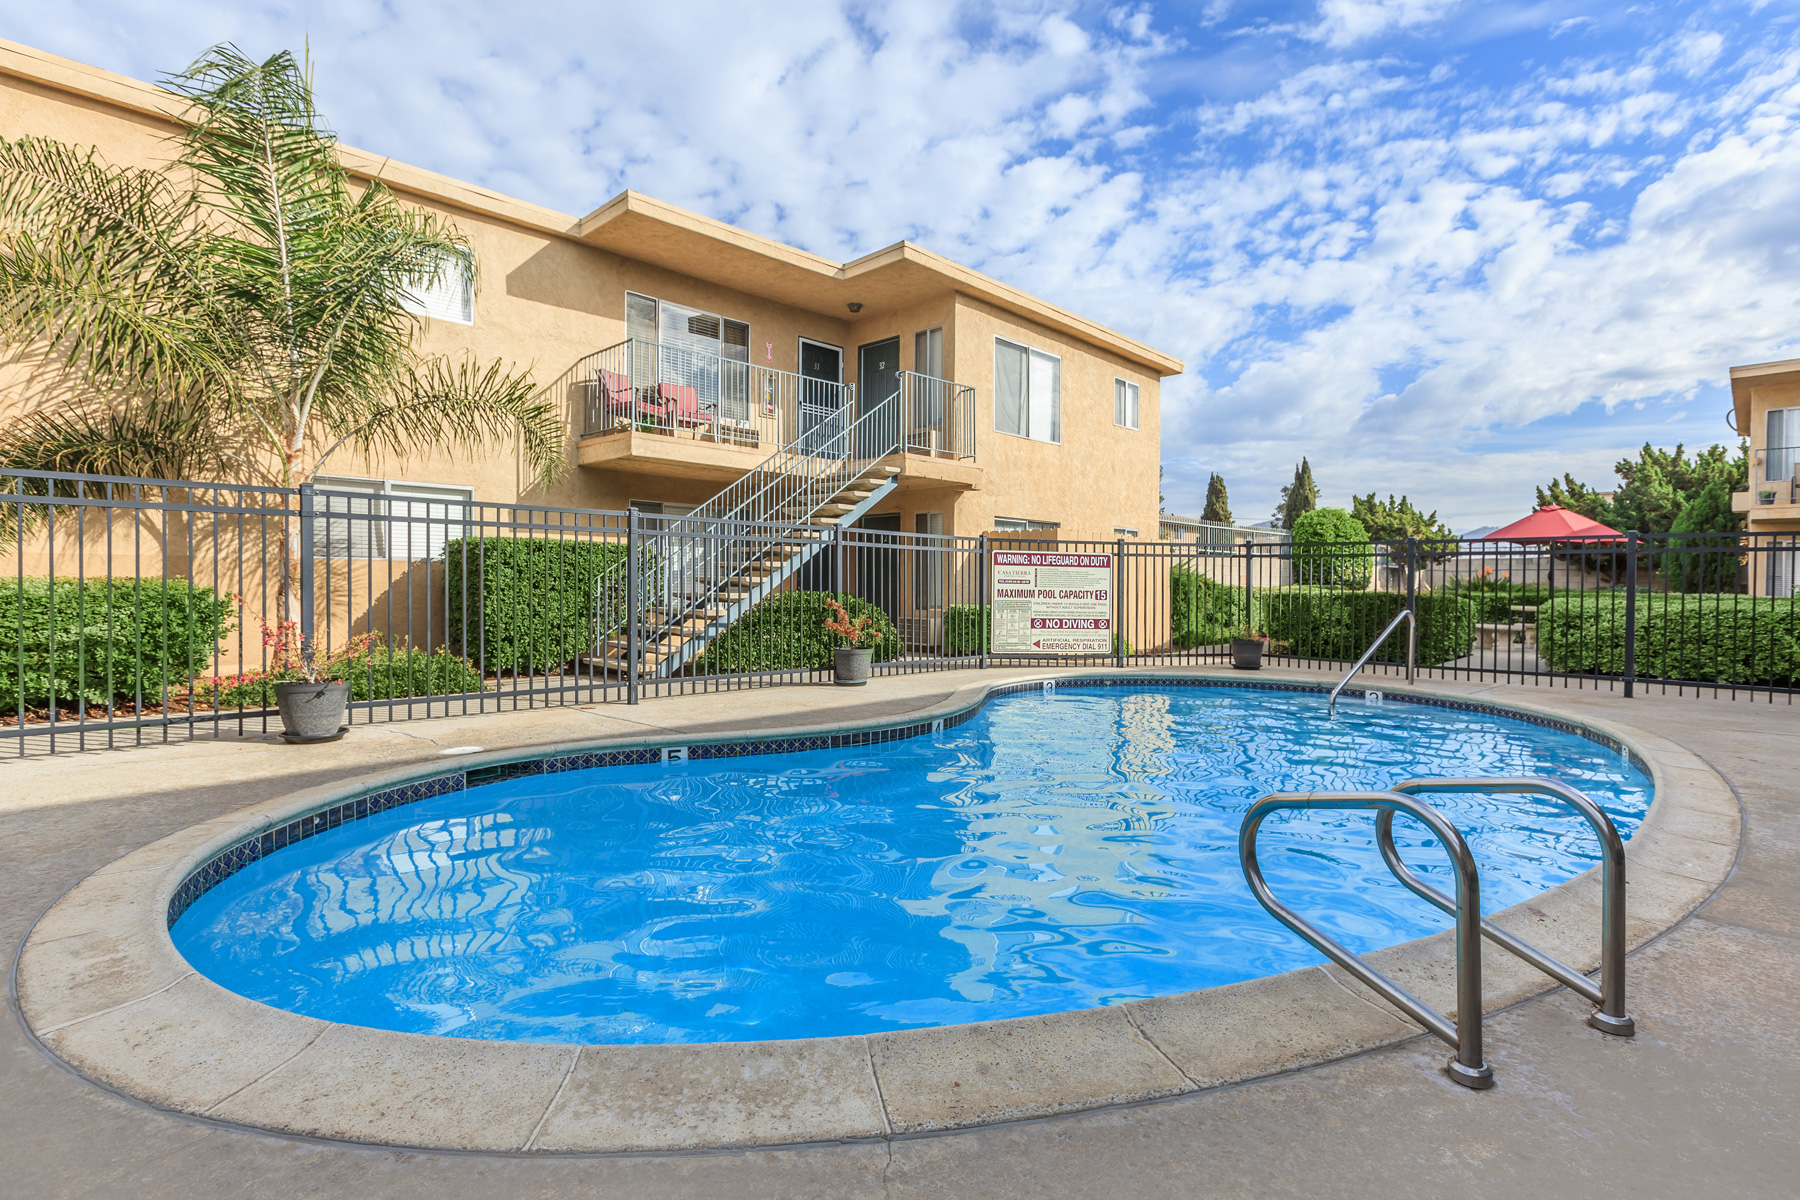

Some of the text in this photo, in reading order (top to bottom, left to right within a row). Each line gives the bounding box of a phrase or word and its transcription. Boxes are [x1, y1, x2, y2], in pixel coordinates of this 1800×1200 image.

[996, 554, 1108, 566] WARNING: NO LIFEGUARD ON DUTY
[997, 589, 1106, 600] MAXIMUM POOL CAPACITY 15
[1046, 620, 1094, 628] NO DIVING
[668, 749, 682, 760] 5
